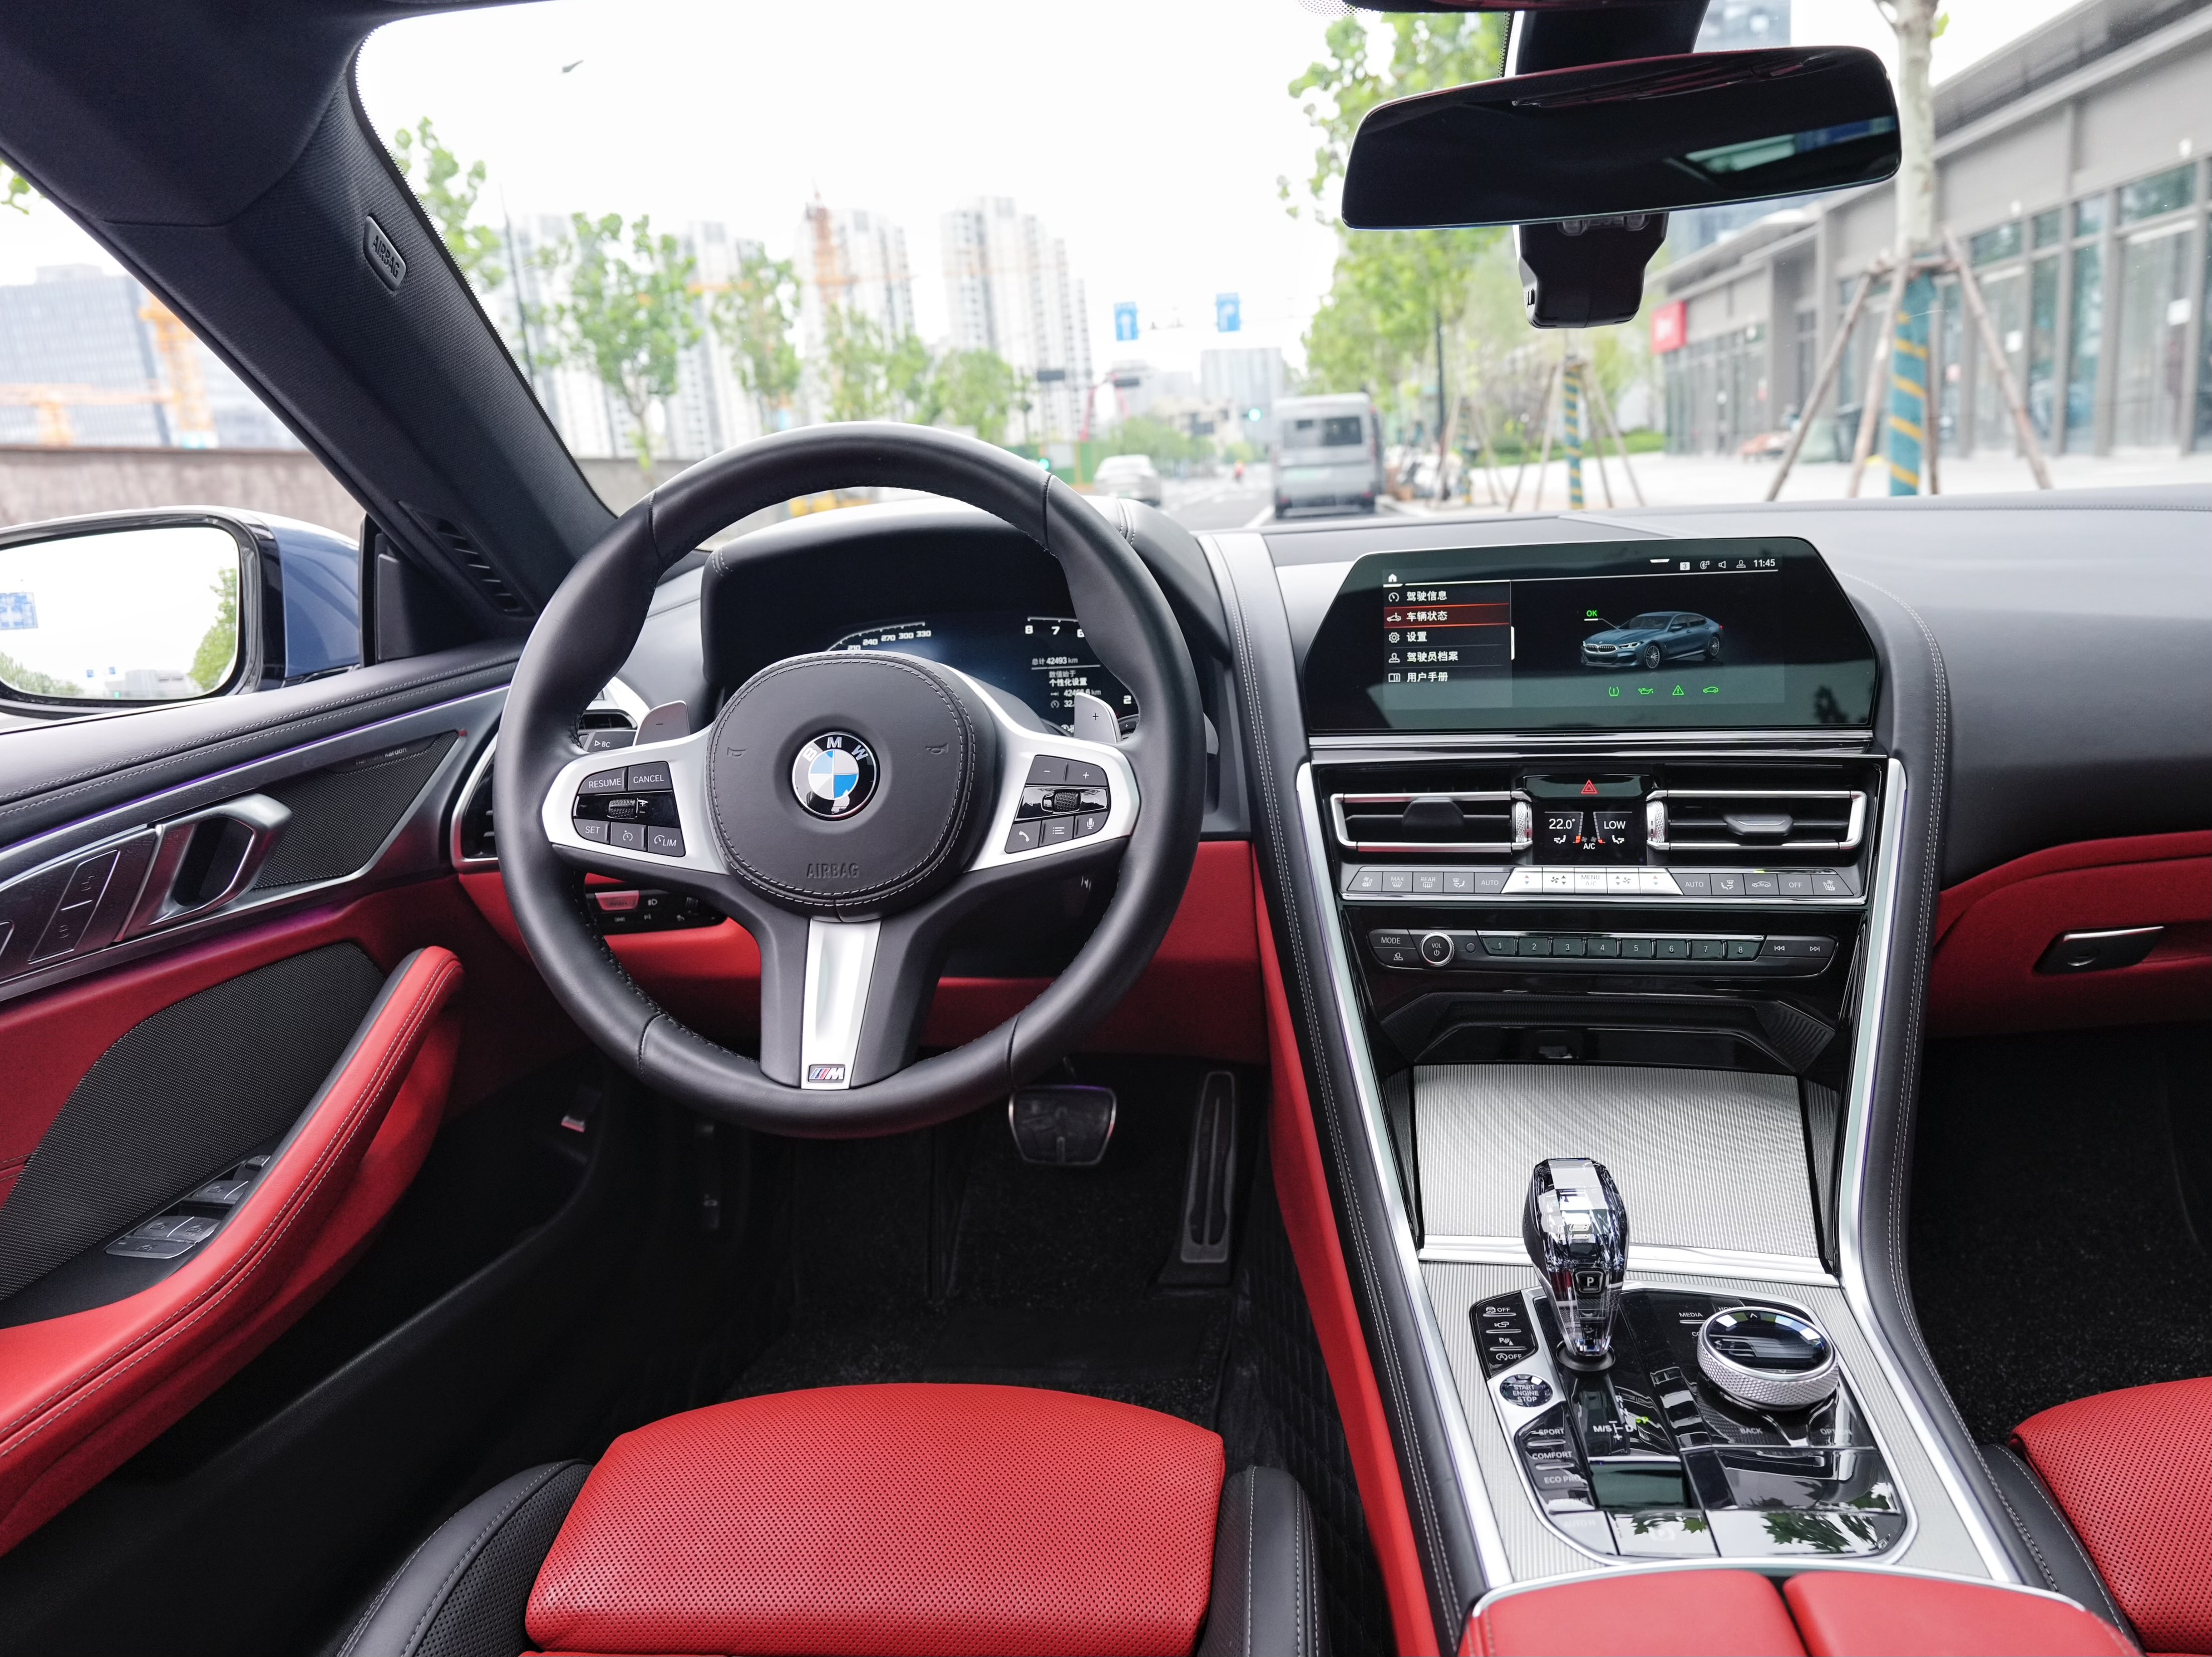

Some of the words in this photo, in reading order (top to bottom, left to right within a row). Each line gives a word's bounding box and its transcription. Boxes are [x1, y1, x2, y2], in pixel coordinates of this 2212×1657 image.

[371, 235, 400, 279] AIRBAG
[1753, 559, 1776, 567] 11:45
[1406, 590, 1447, 602] 驾驶信息
[1406, 611, 1448, 622] 车辆状态
[1025, 625, 1034, 634] 8
[1052, 626, 1060, 635] 7
[862, 638, 878, 646] 240
[1406, 632, 1427, 642] 设置
[1046, 657, 1067, 665] 42493
[1407, 651, 1458, 663] 驾驶员档案
[1049, 677, 1087, 687] 个性化设置
[1407, 672, 1448, 683] 用户手册
[1123, 695, 1132, 704] 2
[802, 736, 868, 762] BMW
[588, 778, 622, 789] RESUME
[633, 775, 664, 784] CANCEL
[1604, 821, 1626, 829] LOW
[662, 839, 677, 847] LIM
[806, 862, 859, 879] AIRBAG
[1586, 1276, 1594, 1287] P
[1625, 1424, 1634, 1432] D
[1532, 1451, 1572, 1460] COMFORT
[1544, 1475, 1562, 1484] ECO
